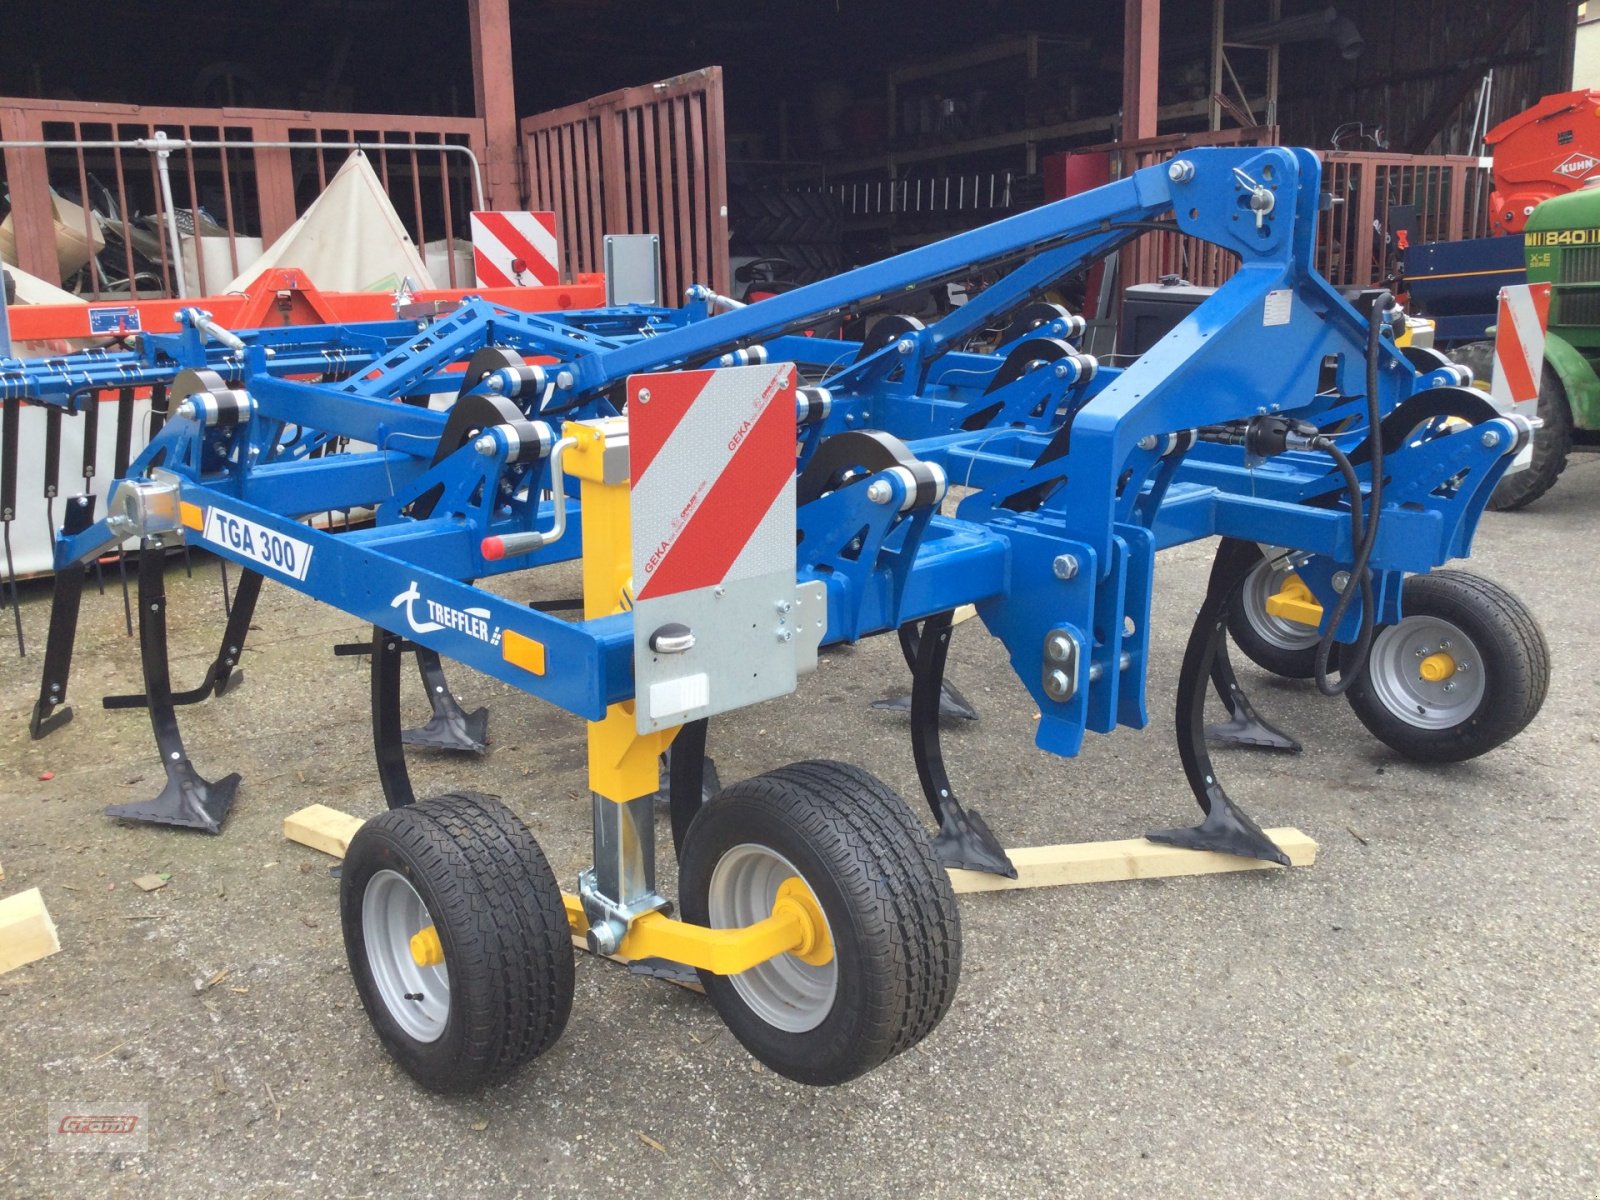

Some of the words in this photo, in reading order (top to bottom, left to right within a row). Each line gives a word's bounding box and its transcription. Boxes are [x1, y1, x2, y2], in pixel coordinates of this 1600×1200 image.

[1560, 158, 1593, 173] KUHN
[1545, 229, 1586, 246] 840
[1530, 253, 1550, 263] X-E
[727, 420, 751, 452] GEKA
[216, 513, 255, 556] TGA
[259, 531, 295, 572] 300
[644, 541, 670, 573] GEKA
[426, 599, 489, 642] TREFFLER
